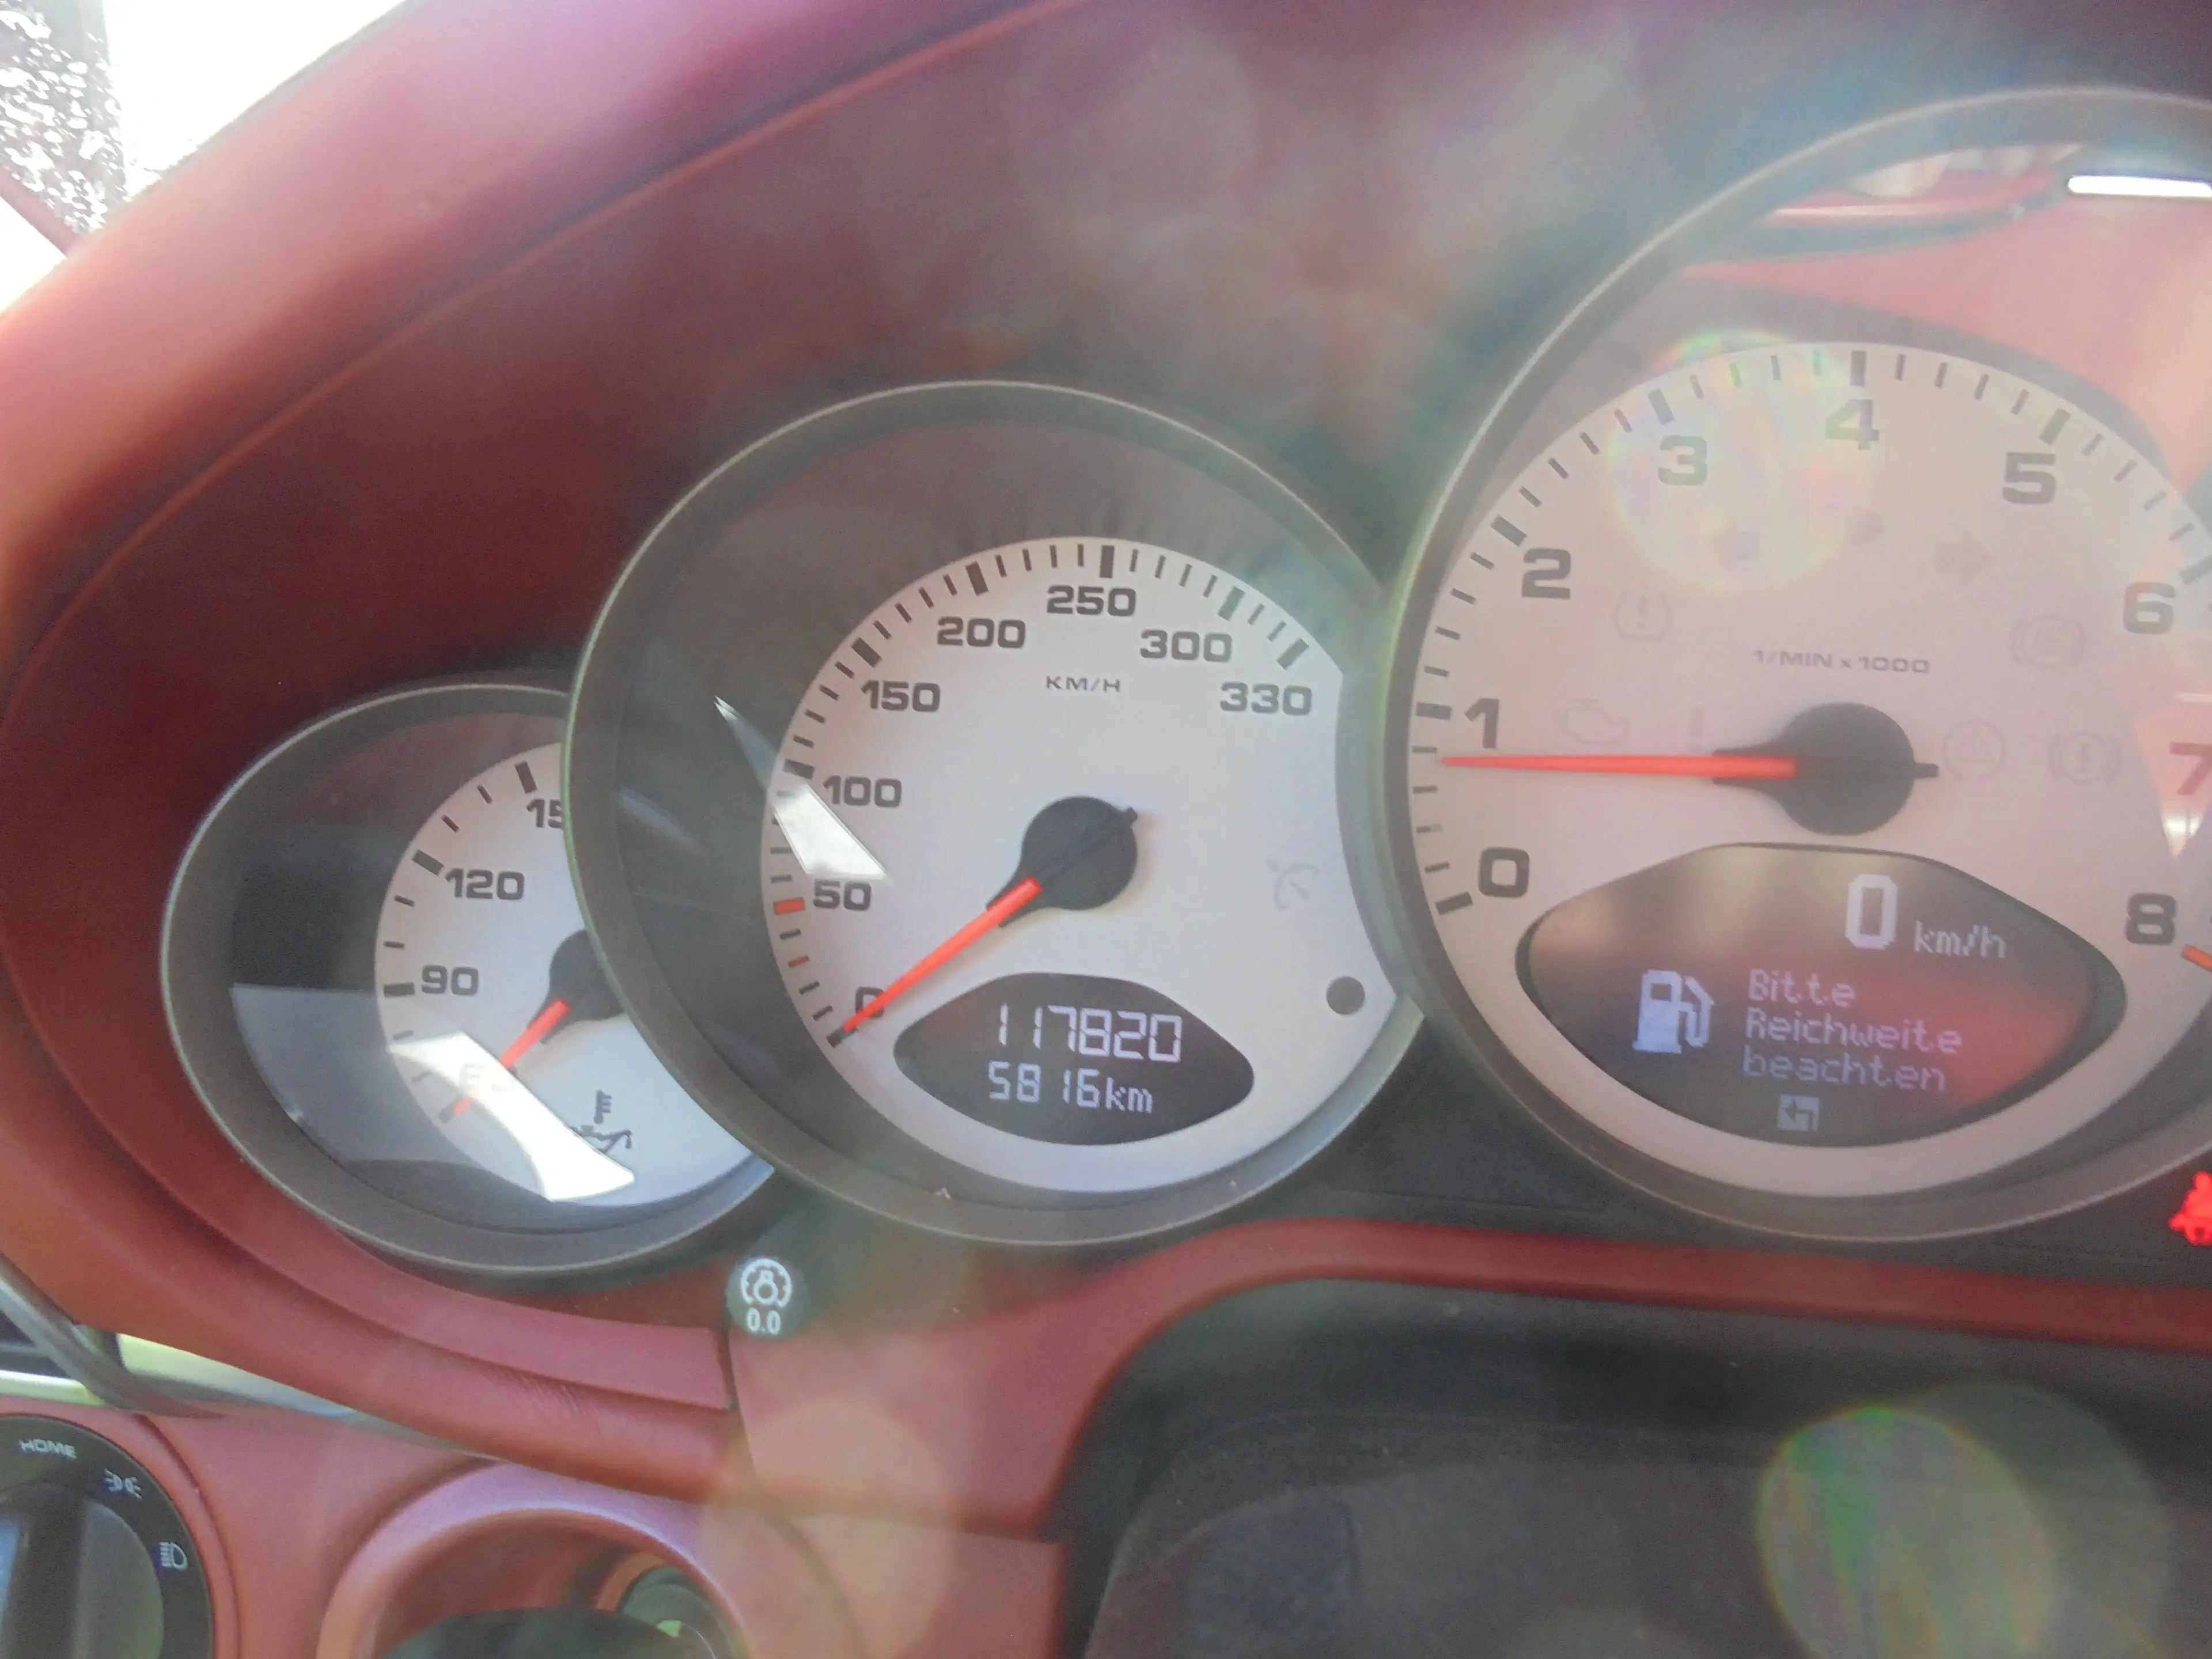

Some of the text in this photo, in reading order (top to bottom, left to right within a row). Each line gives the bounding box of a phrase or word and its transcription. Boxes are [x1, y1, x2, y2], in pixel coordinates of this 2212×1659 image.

[1824, 399, 1880, 450] 4
[1658, 435, 1708, 486] 3
[2002, 452, 2057, 505] 5
[1521, 548, 1572, 600] 2
[1046, 585, 1137, 617] 250
[2123, 581, 2176, 635] 6
[936, 616, 1027, 649] 200
[1139, 629, 1233, 662] 300
[1046, 675, 1122, 693] KM/H
[1858, 656, 1929, 673] 1000
[860, 680, 941, 713] 150
[1219, 681, 1313, 716] 330
[1464, 697, 1500, 749] 1
[2169, 741, 2212, 796] 7
[822, 774, 903, 808] 100
[444, 868, 525, 901] 120
[1478, 846, 1531, 899] 0
[812, 881, 872, 911] 50
[1845, 873, 2006, 959] 0 km/h
[2125, 892, 2177, 946] 8
[421, 965, 480, 997] 90
[1747, 968, 1857, 1007] Bitte
[998, 1002, 1183, 1063] 117820
[1745, 1006, 1963, 1055] Reichweite
[1743, 1044, 1948, 1092] beachten
[19, 1438, 77, 1460] HOME
